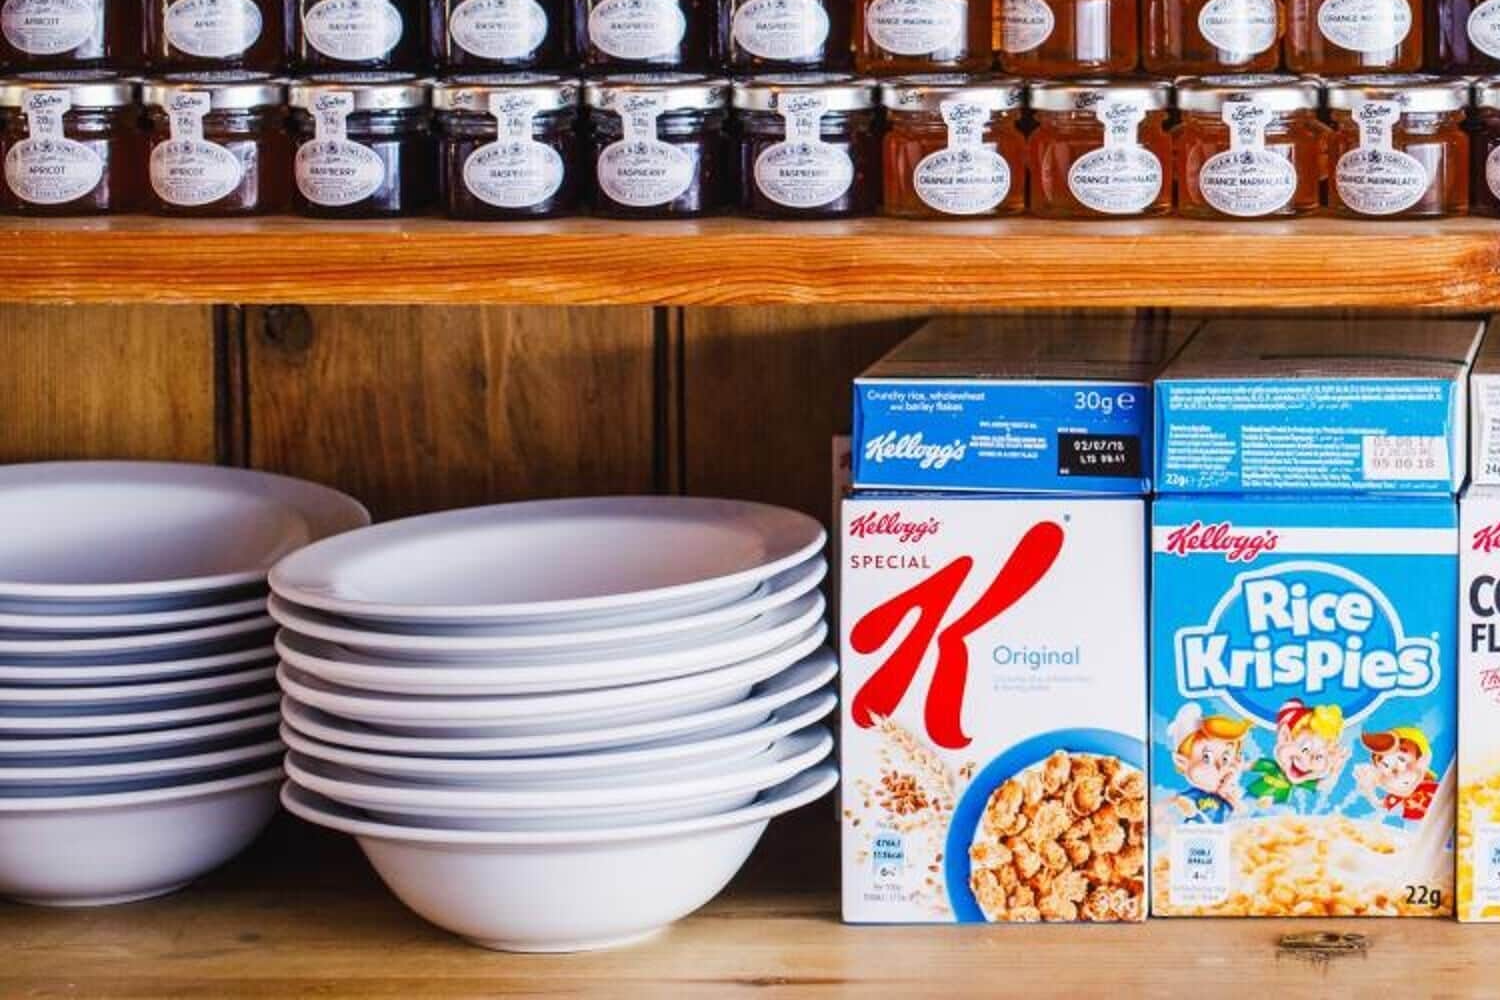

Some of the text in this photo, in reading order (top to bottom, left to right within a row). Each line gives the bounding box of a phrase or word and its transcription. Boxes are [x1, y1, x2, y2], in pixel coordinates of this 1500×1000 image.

[918, 174, 954, 185] ORANGE
[1072, 174, 1110, 186] ORANGE
[1073, 391, 1114, 416] 30g
[864, 429, 968, 470] Kellogg's
[849, 511, 941, 543] Kellogg's
[1166, 522, 1279, 561] Kellogg's
[850, 555, 931, 570] SPECIAL
[1243, 577, 1375, 637] Rice
[849, 520, 1066, 750] K
[992, 644, 1081, 671] Original
[1183, 633, 1434, 694] Krispies
[1404, 884, 1442, 909] 22g
